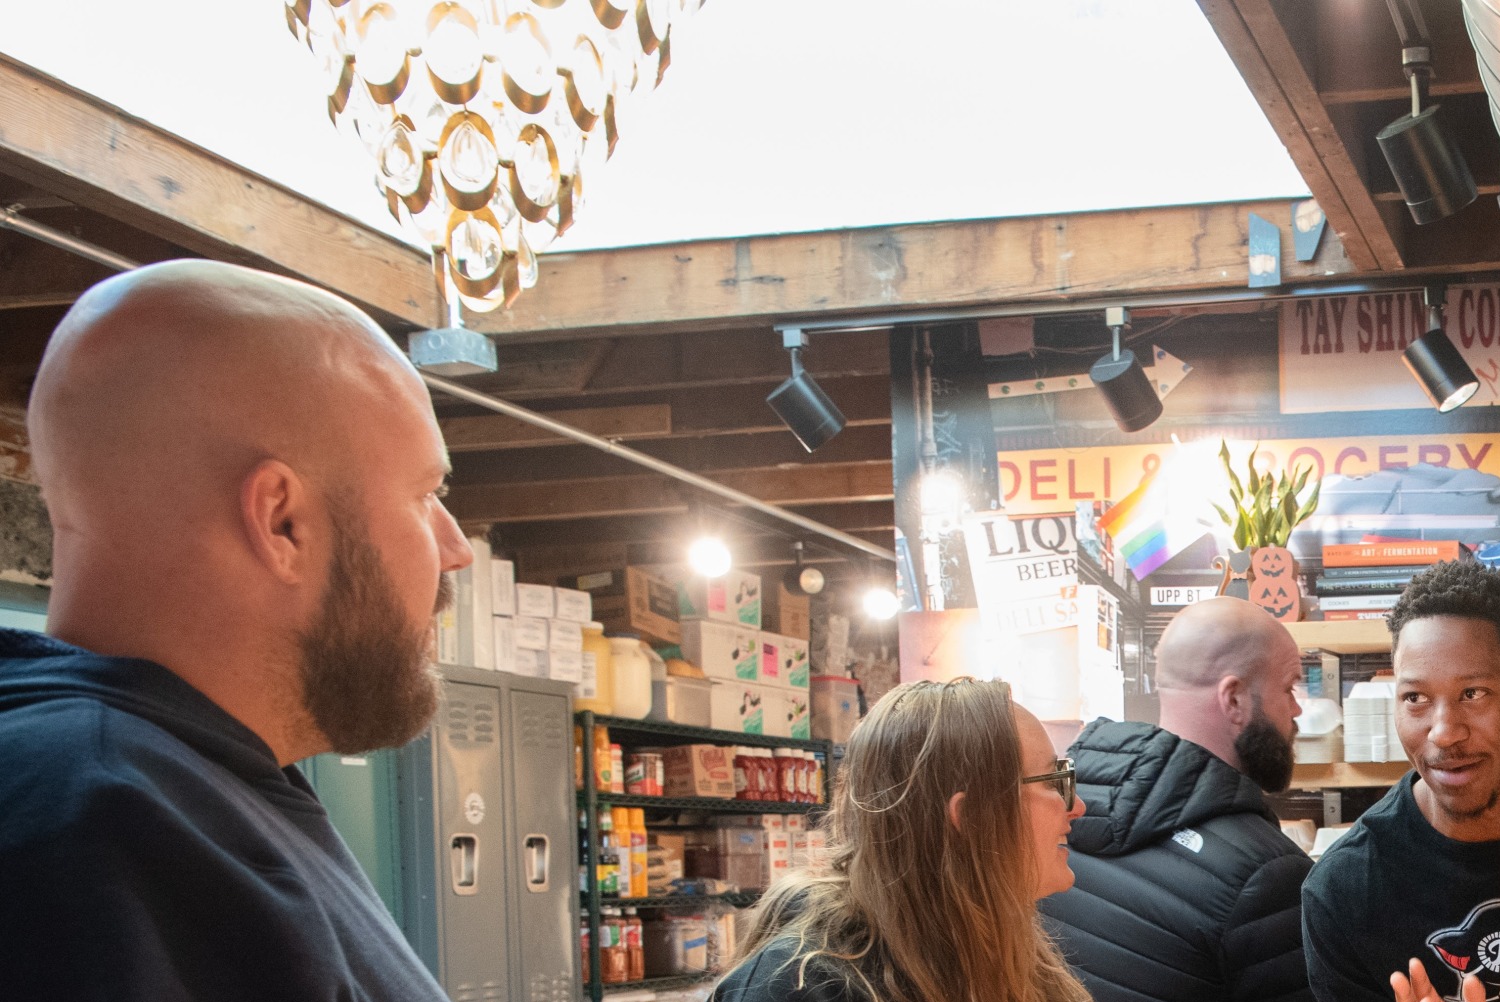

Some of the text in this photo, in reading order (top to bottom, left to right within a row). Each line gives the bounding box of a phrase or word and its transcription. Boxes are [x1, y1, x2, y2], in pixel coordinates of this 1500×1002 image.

[1297, 298, 1348, 355] TAY
[1357, 293, 1447, 354] SHIN
[999, 457, 1111, 501] DELI
[1361, 548, 1375, 557] ART
[1383, 547, 1438, 556] FERMENTATION
[1017, 557, 1078, 582] BEER
[1157, 589, 1180, 603] UPP
